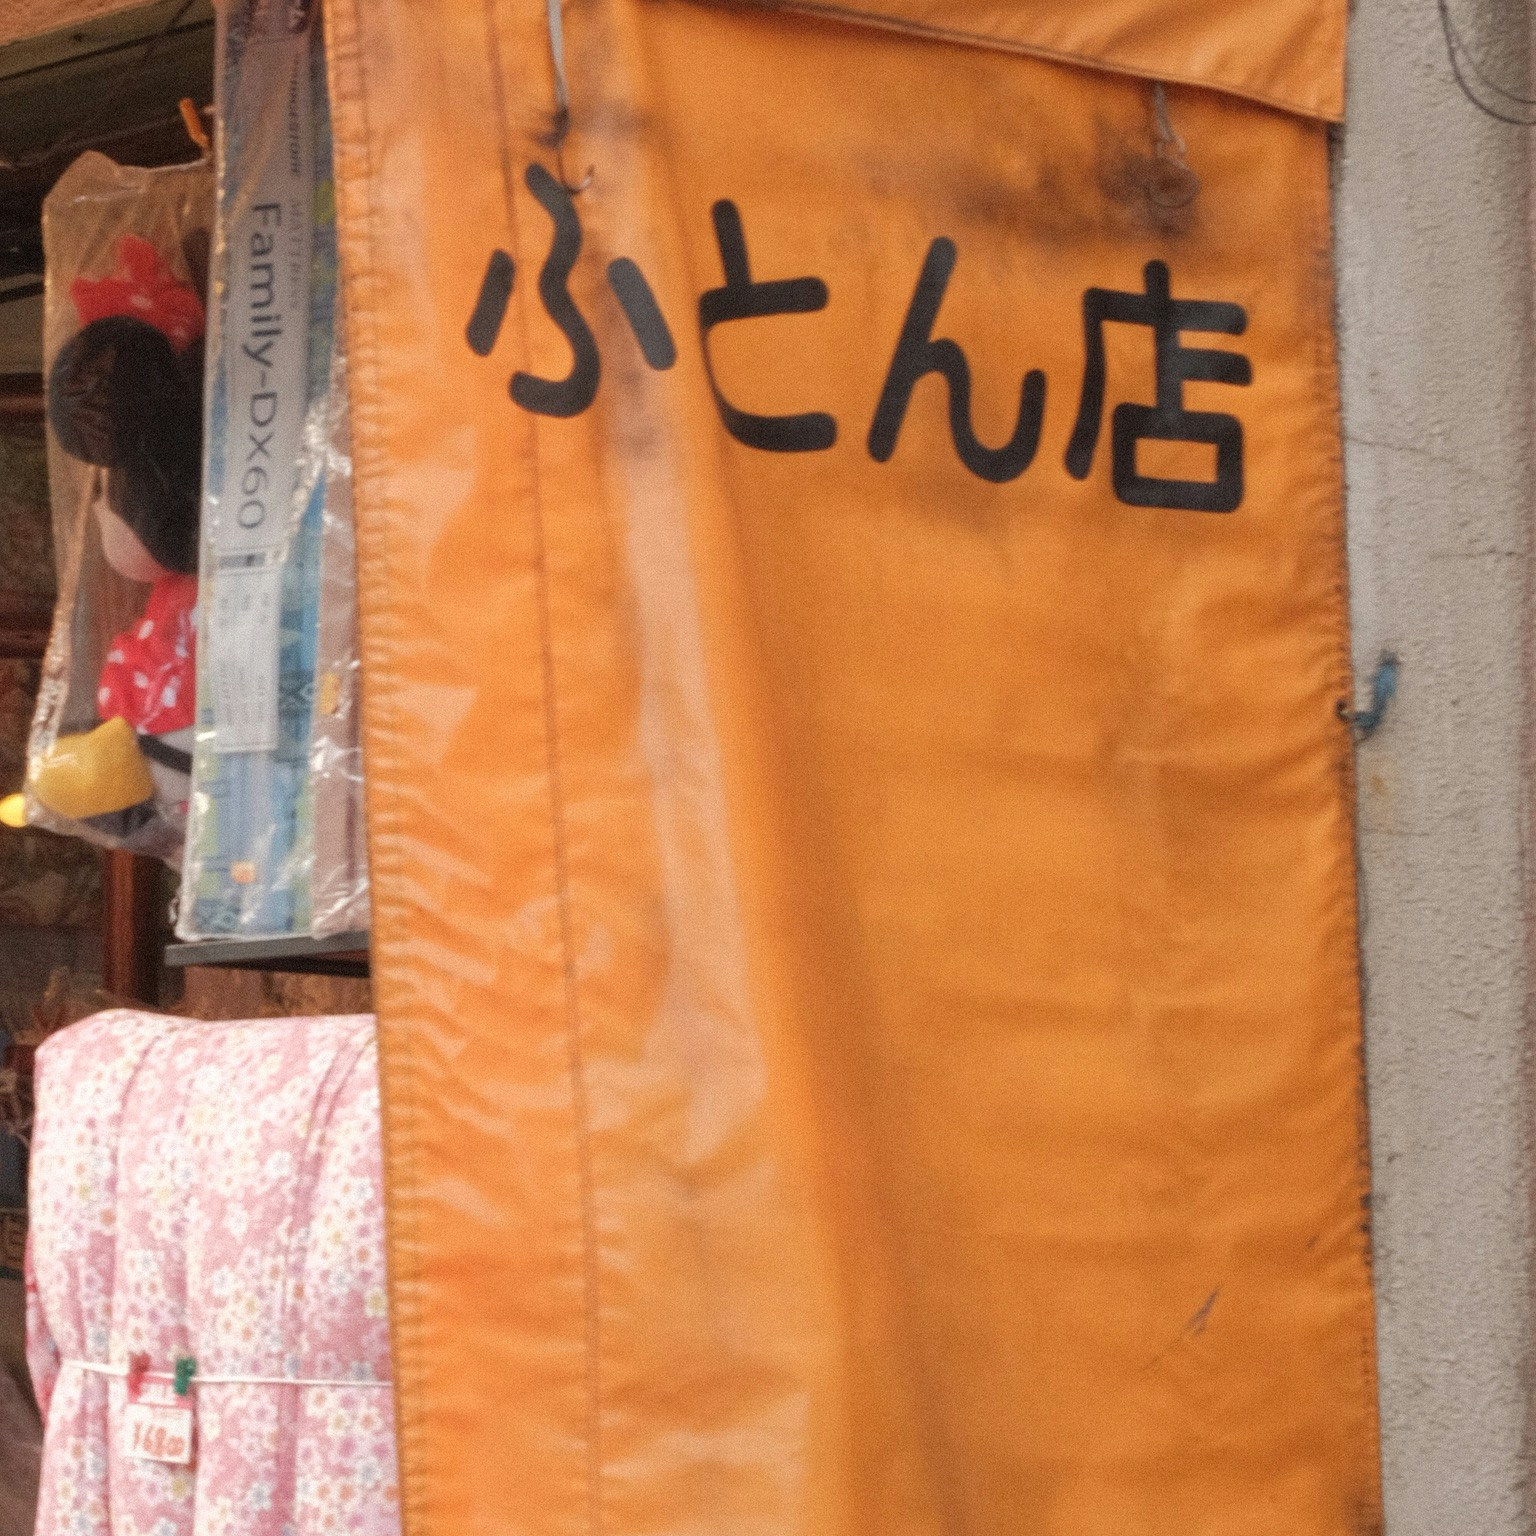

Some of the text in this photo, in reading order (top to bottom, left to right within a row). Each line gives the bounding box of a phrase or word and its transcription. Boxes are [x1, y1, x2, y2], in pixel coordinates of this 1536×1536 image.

[238, 201, 282, 530] Family-DX60
[466, 163, 1252, 513] ふとん店
